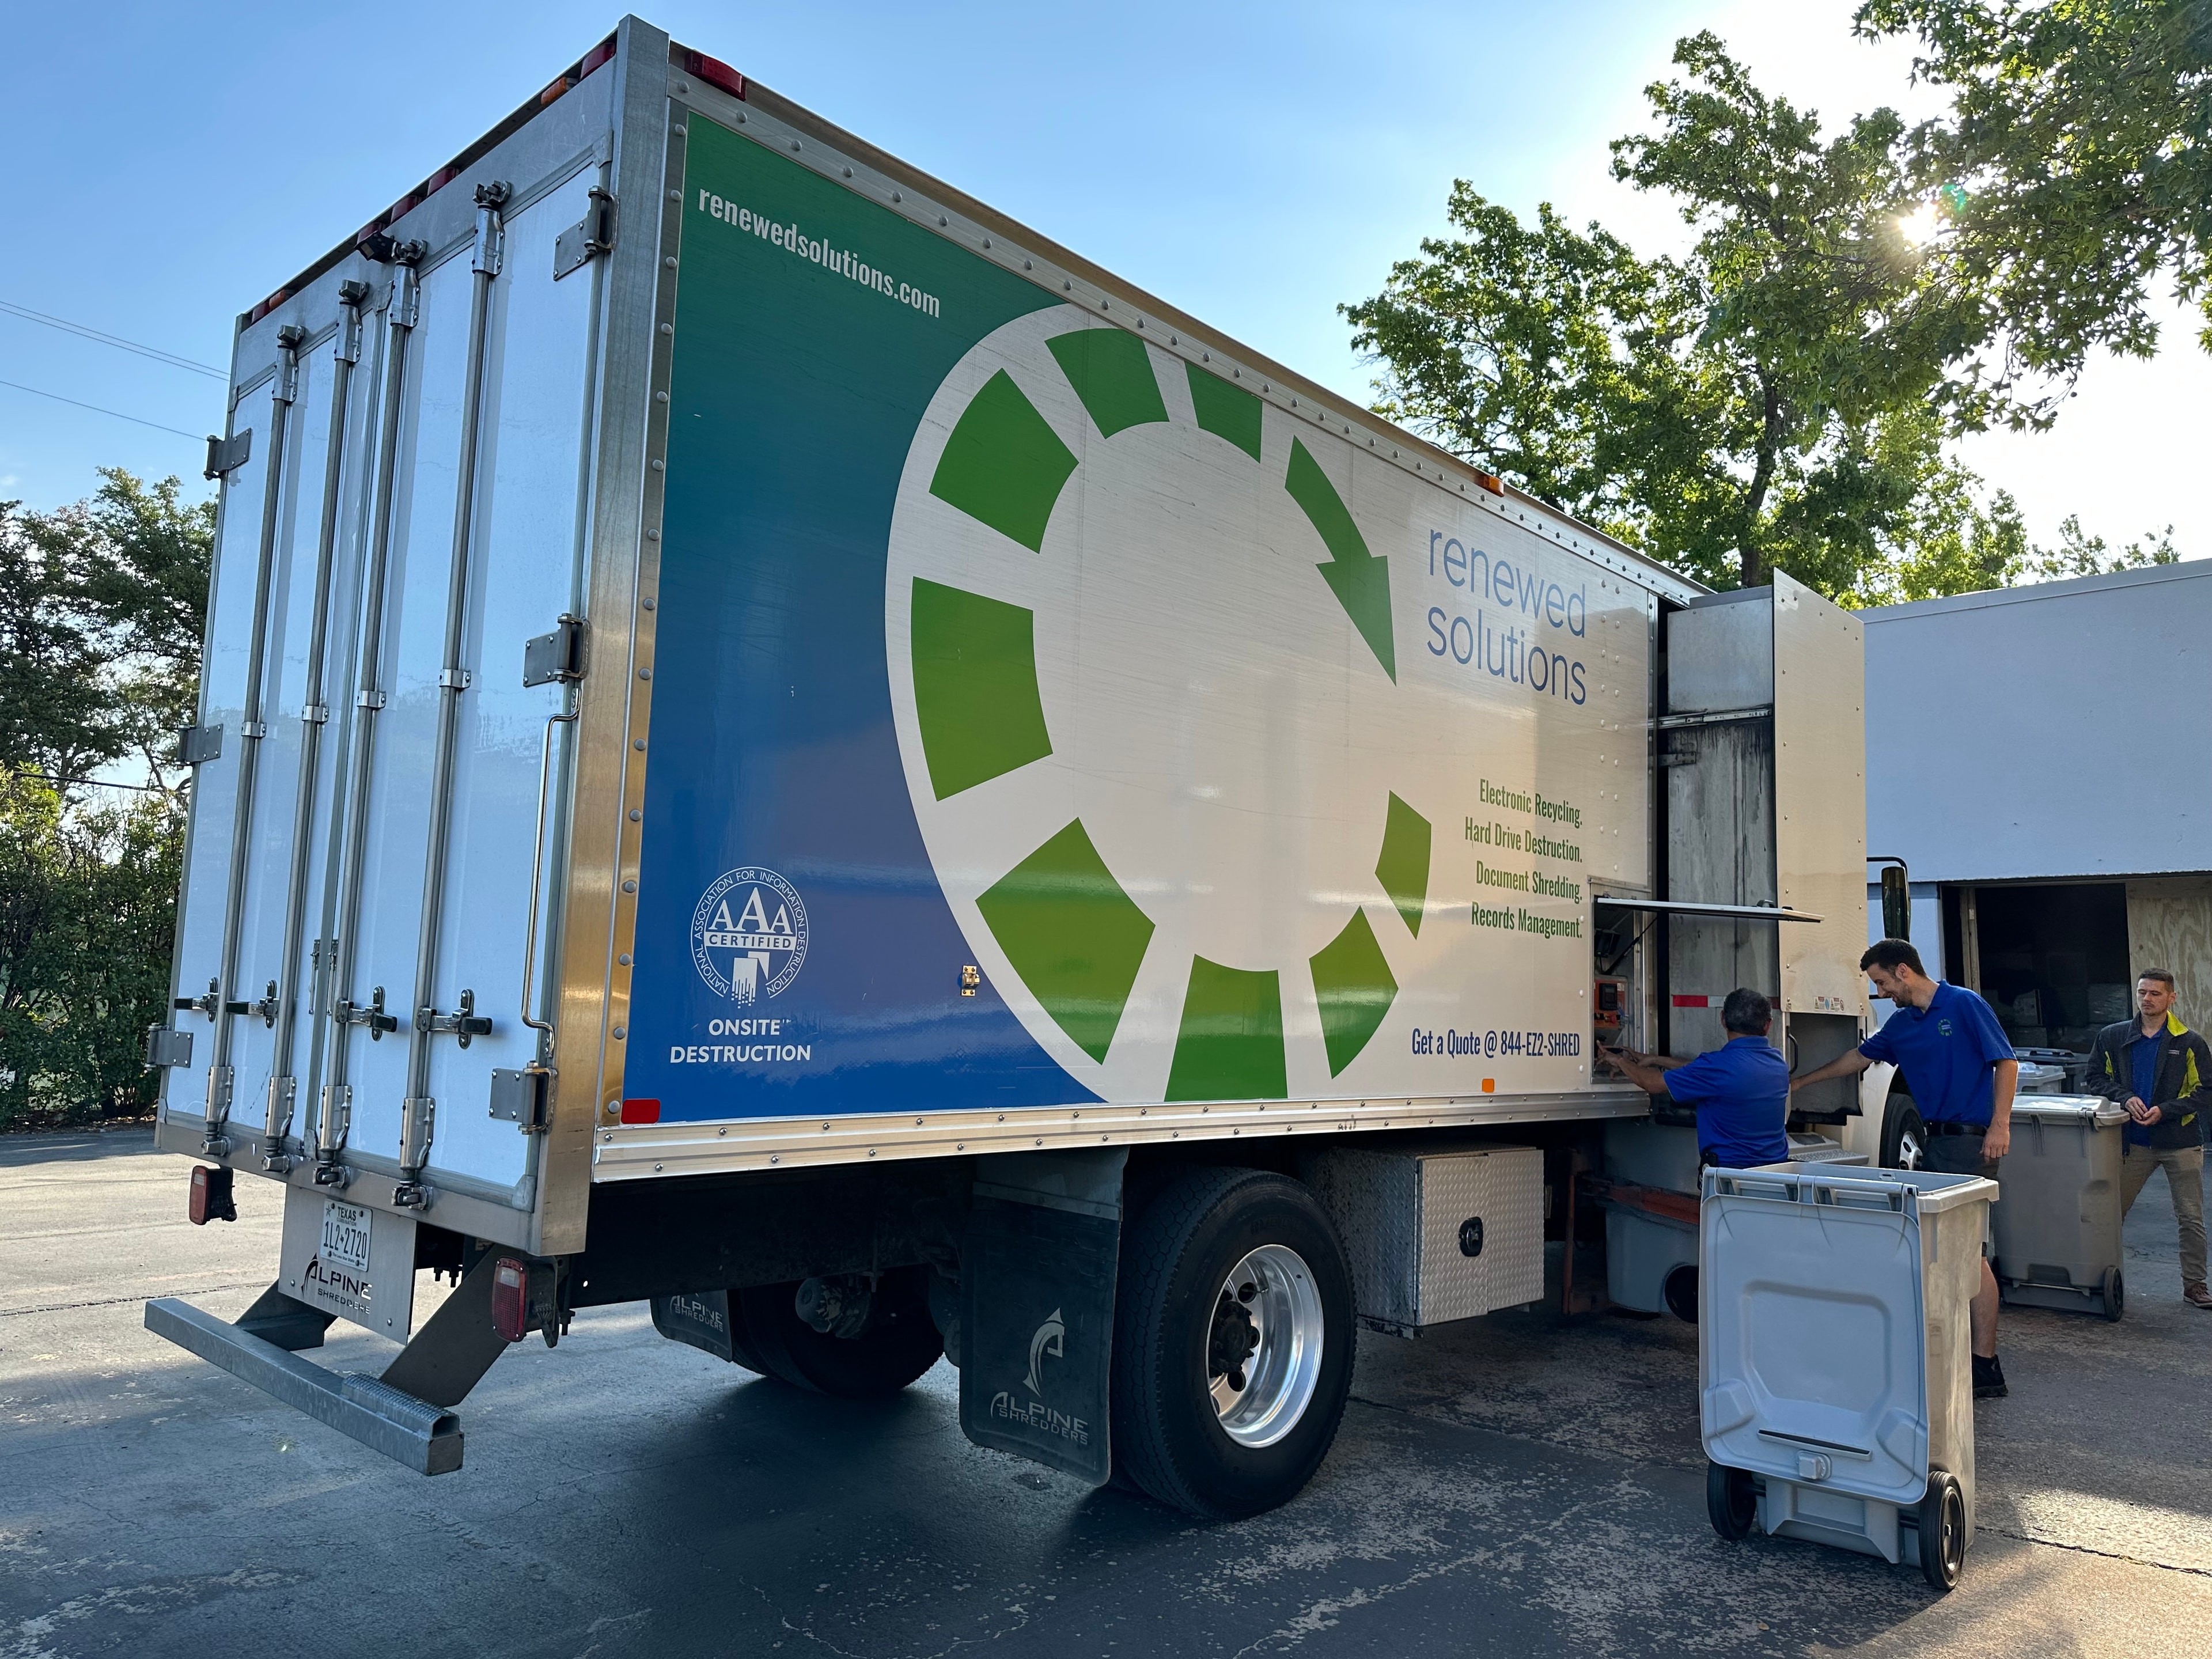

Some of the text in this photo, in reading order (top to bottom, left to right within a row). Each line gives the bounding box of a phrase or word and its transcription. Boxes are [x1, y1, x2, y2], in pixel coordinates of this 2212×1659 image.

[698, 188, 940, 318] renewedsolutions.com
[1430, 529, 1585, 638] renewed
[1427, 607, 1586, 705] solutions
[1480, 778, 1582, 829] Electronic Recycling.
[1465, 816, 1582, 863] Hard Drive Destruction.
[1476, 860, 1582, 904] Document Shredding.
[709, 887, 793, 934] AAA
[1472, 901, 1582, 939] Records Management.
[694, 870, 806, 995] NATIONAL ASSOCIATION FOR INFORMATION DESTRUCTION
[709, 934, 791, 948] CERTIFIED
[670, 1045, 811, 1063] DESTRUCTION
[1412, 1028, 1580, 1059] Get a Quote @ 844-EZ2-SHRED
[338, 1206, 357, 1221] TEXAS
[303, 1260, 372, 1300] ALPINE
[670, 1296, 722, 1325] ALPINE
[675, 1306, 724, 1332] SHREDDERS
[990, 1391, 1088, 1435] ALPINE
[999, 1408, 1088, 1445] SHREDDERS
